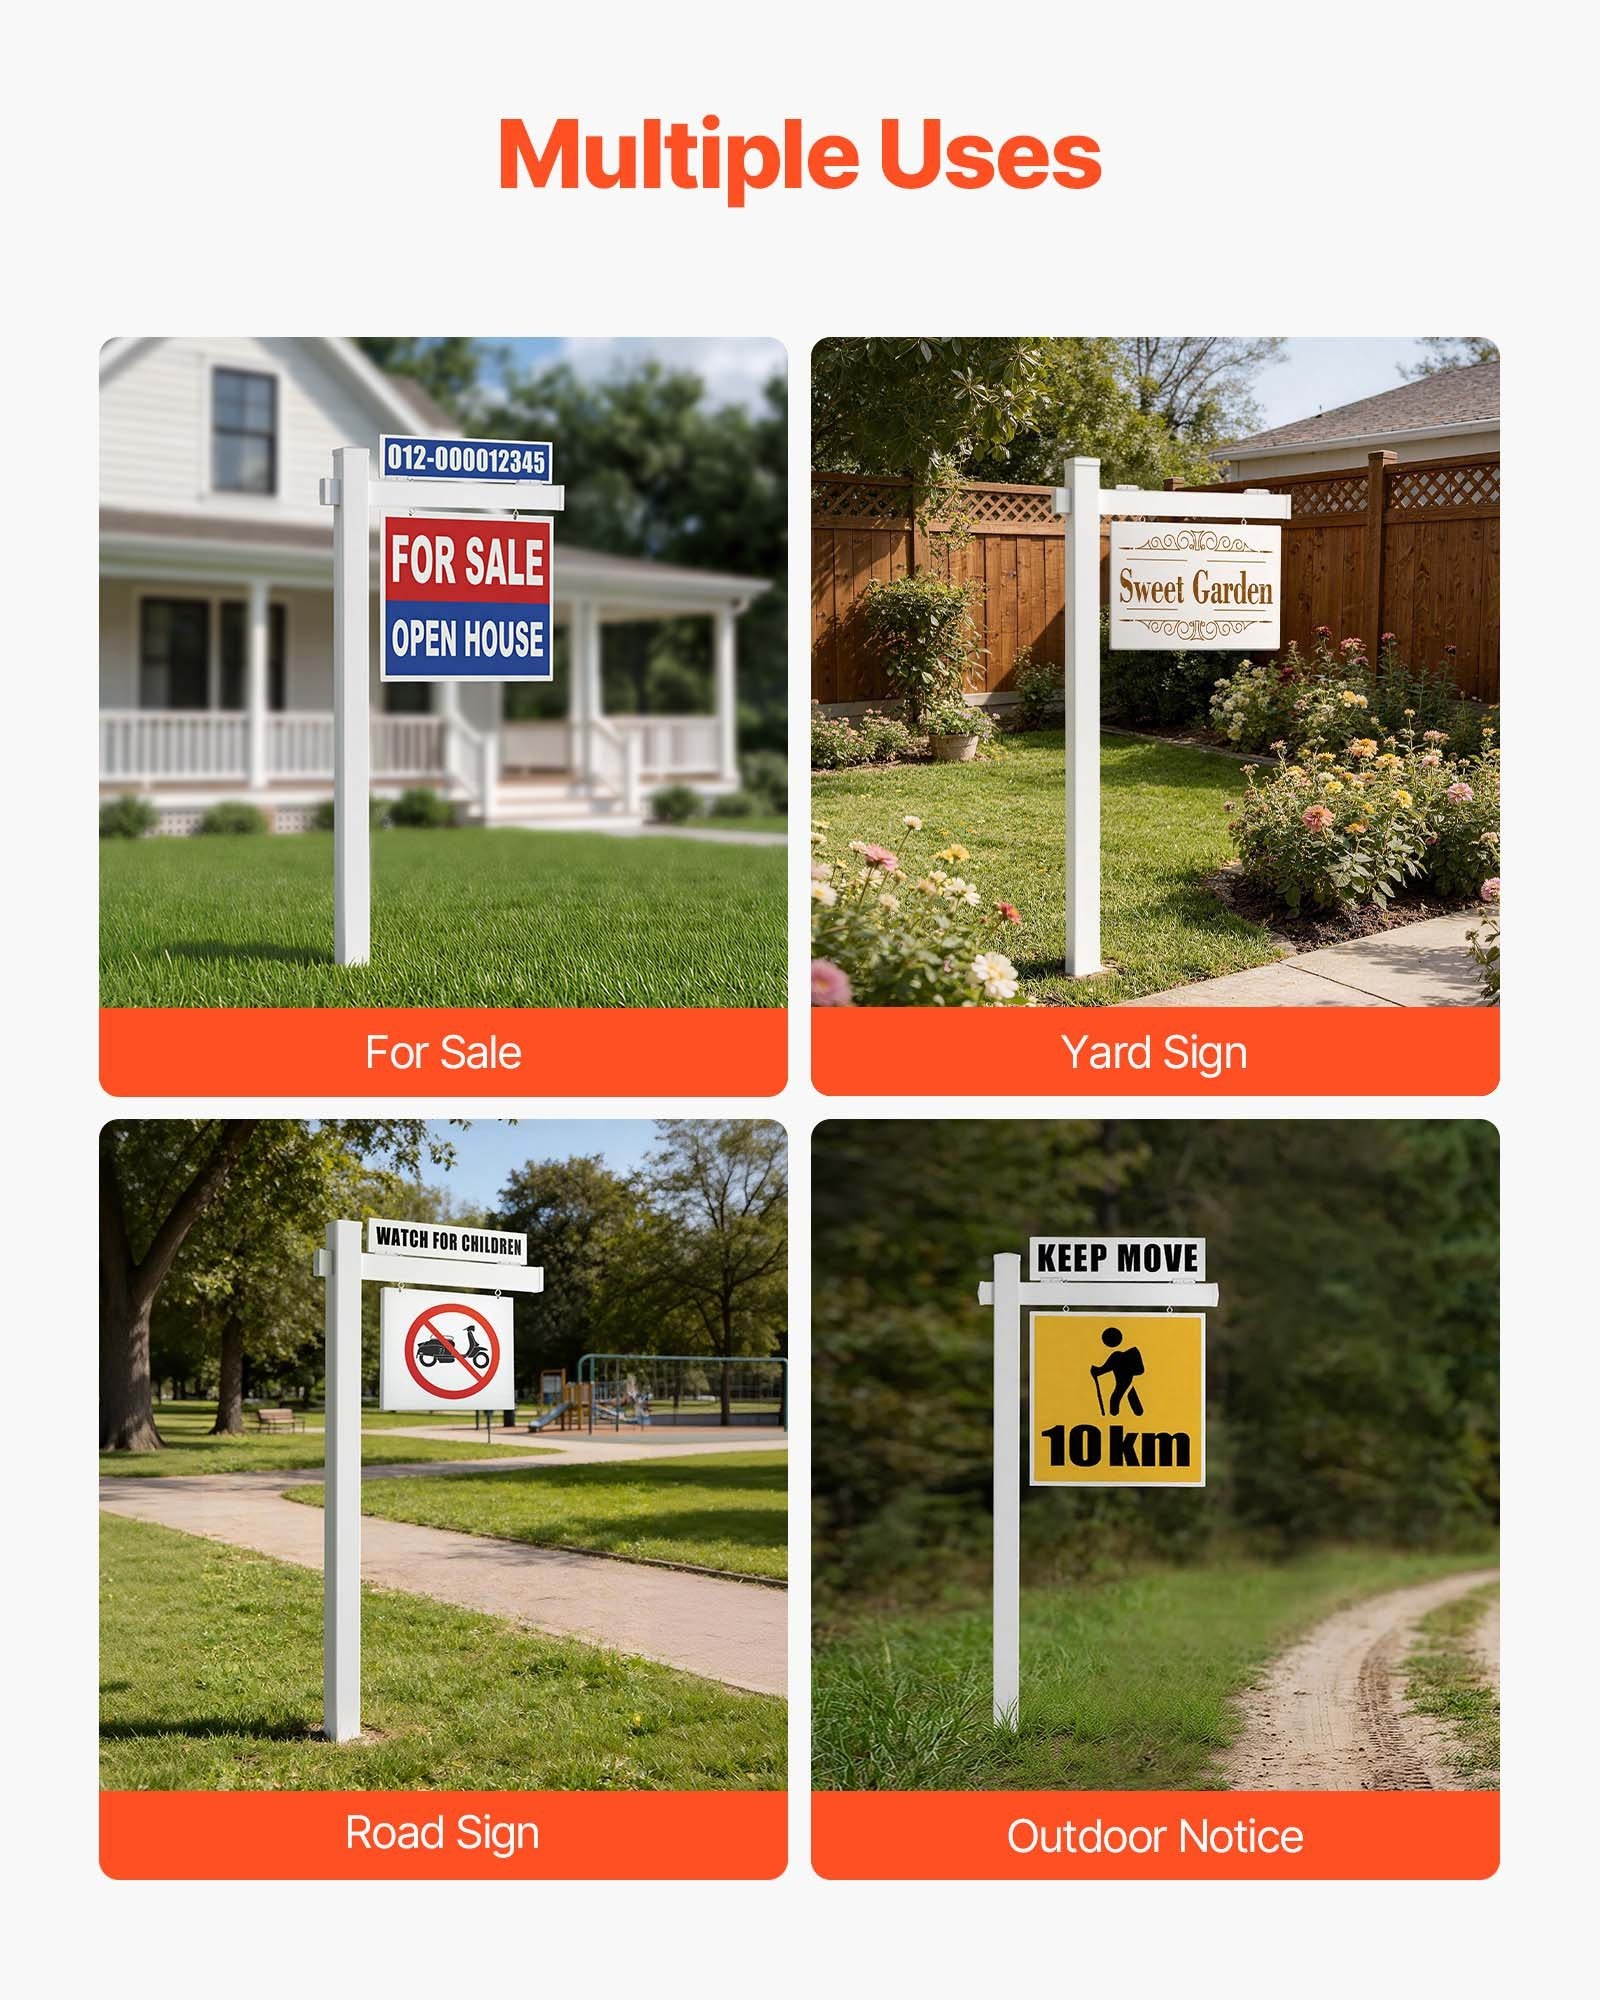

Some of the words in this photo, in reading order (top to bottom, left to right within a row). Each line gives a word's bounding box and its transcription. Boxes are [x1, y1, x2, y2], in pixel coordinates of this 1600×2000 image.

[388, 444, 545, 474] 012-000012345
[393, 535, 455, 583] FOR
[466, 537, 543, 585] SALE
[1120, 568, 1184, 603] Sweet
[1193, 570, 1273, 604] Garden
[393, 619, 456, 656] OPEN
[465, 621, 543, 657] HOUSE
[376, 1227, 428, 1248] WATCH
[433, 1232, 457, 1250] FOR
[461, 1234, 522, 1256] CHILDREN
[1038, 1244, 1106, 1272] KEEP
[1118, 1244, 1197, 1272] MOVE
[1042, 1425, 1101, 1467] 10
[1110, 1426, 1190, 1466] km
